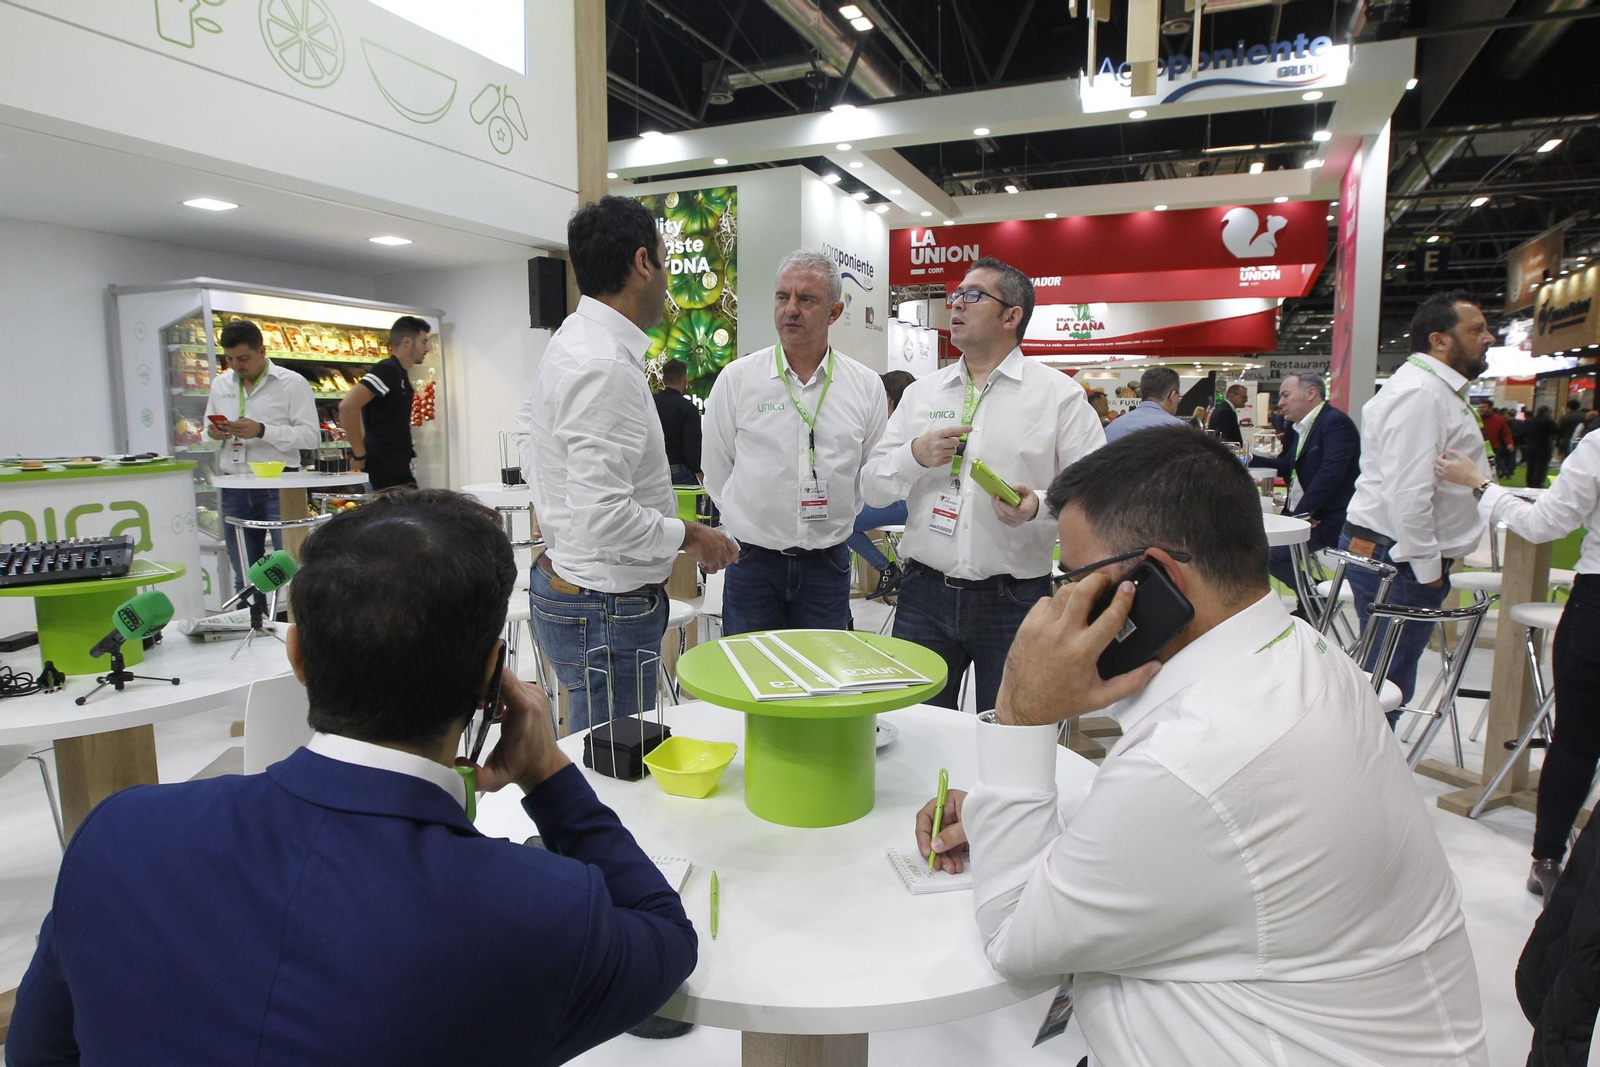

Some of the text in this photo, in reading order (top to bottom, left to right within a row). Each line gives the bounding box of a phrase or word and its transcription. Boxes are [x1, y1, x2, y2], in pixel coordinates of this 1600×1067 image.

[910, 229, 937, 247] LA
[910, 244, 980, 265] UNION
[1424, 250, 1440, 271] E
[1240, 269, 1281, 281] UNION
[1056, 320, 1106, 332] LA CAÑA
[929, 410, 955, 419] unica
